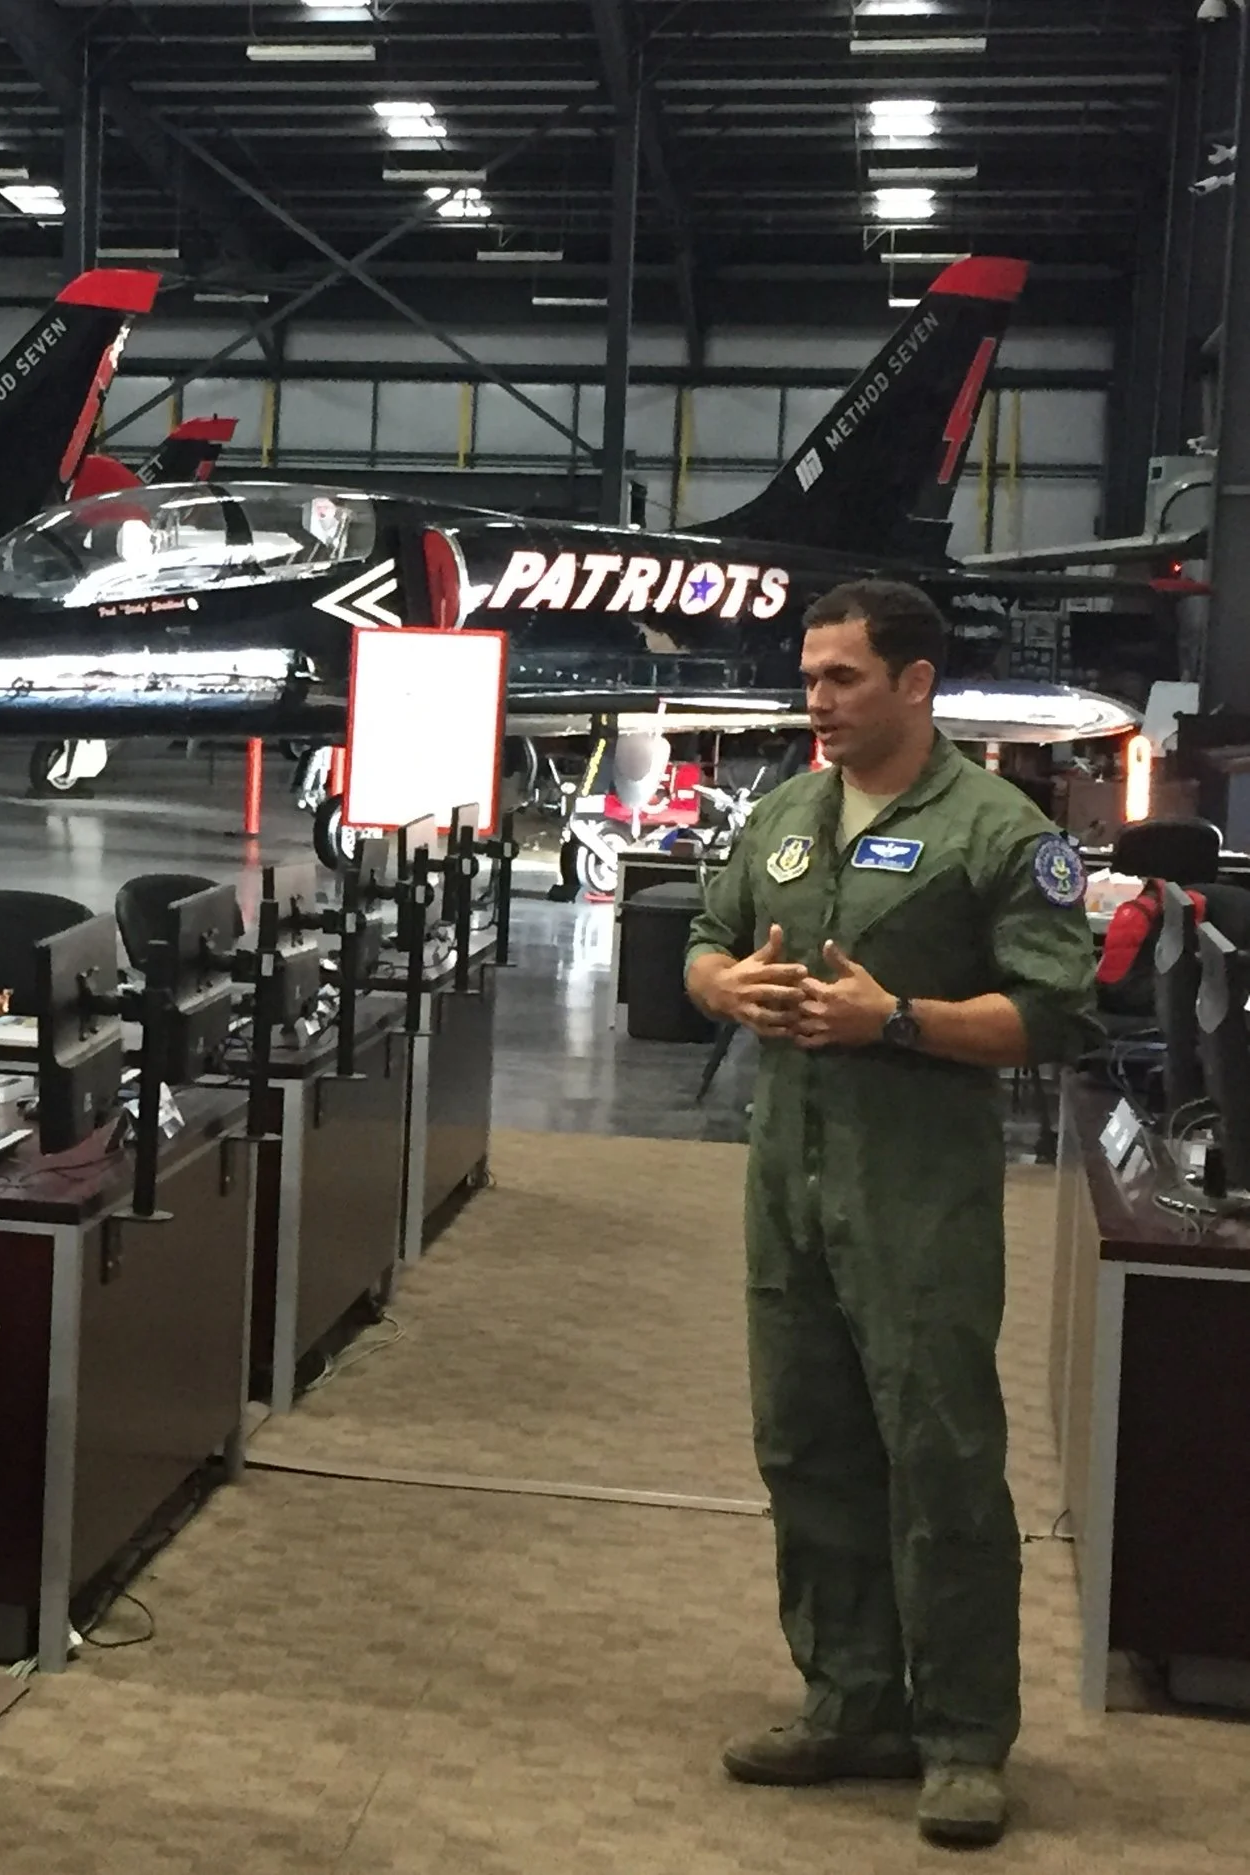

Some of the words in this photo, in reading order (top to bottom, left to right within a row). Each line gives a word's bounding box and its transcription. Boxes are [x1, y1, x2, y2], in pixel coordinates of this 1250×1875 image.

[15, 317, 67, 376] SEVEN
[824, 372, 889, 452] METHOD
[888, 312, 940, 375] SEVEN
[486, 550, 790, 619] PATRIOTS
